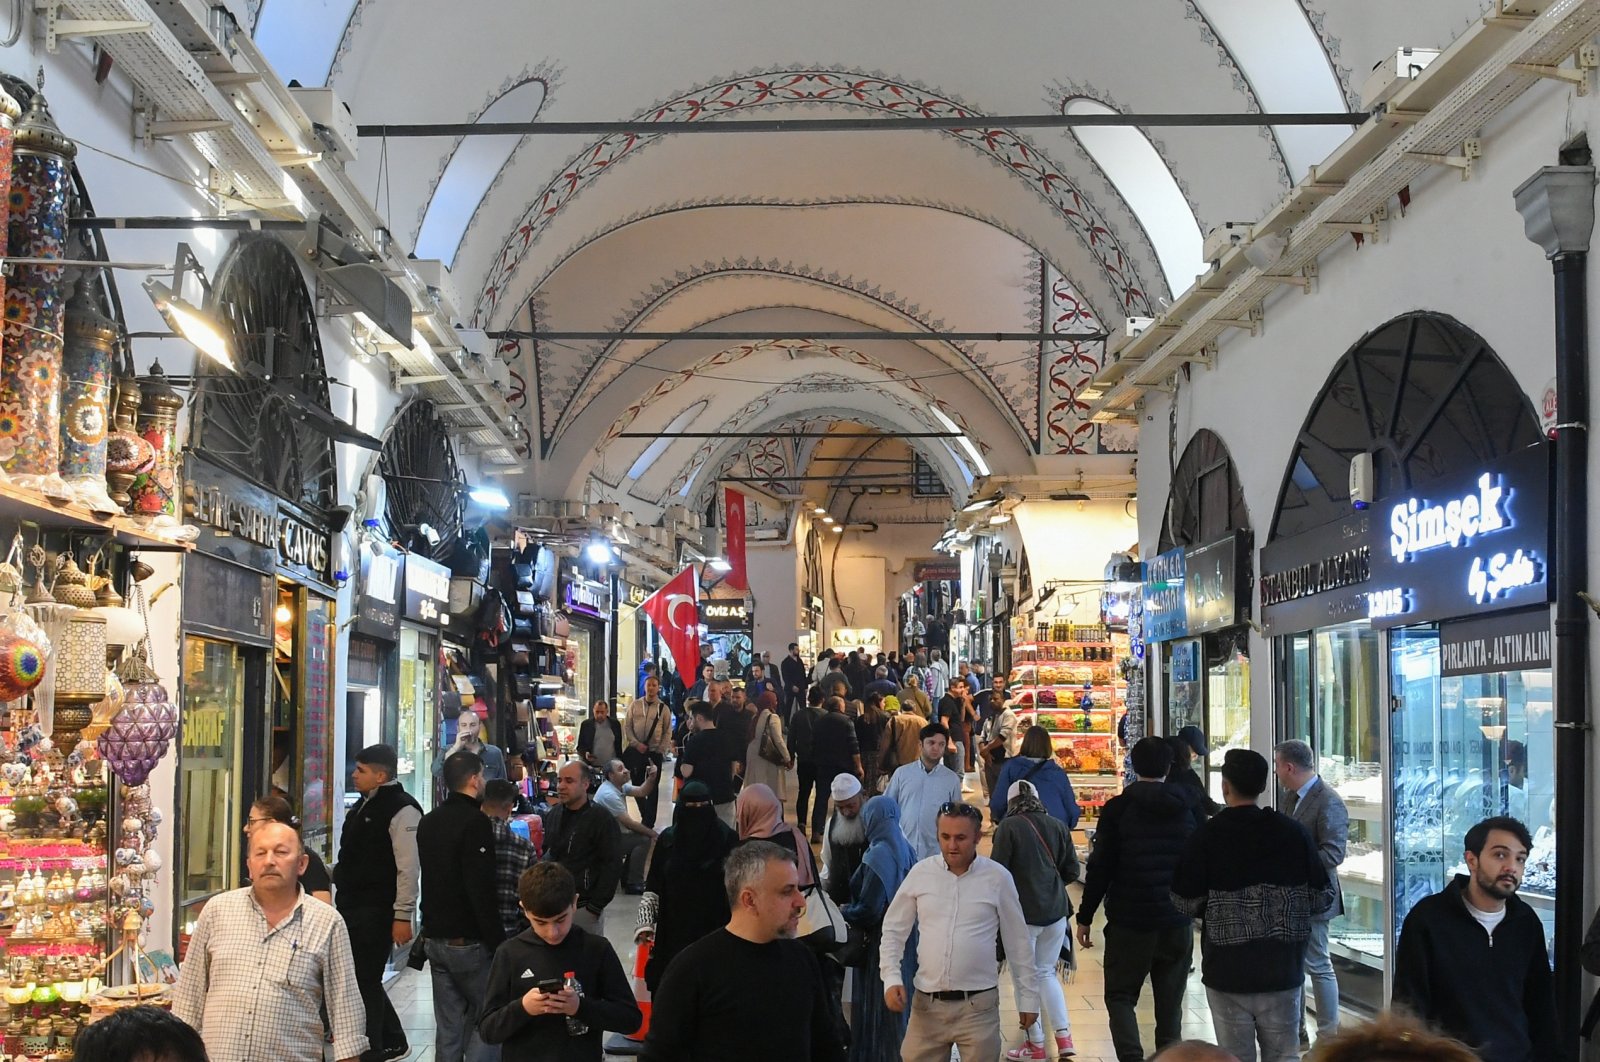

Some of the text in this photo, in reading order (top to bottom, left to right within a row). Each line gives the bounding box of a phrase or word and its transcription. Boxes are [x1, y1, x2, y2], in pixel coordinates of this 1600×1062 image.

[1390, 472, 1503, 563] Şimşek
[283, 517, 328, 581] ÇAVUŞ
[1442, 639, 1487, 670] PIRLANTA
[1493, 633, 1523, 665] ALTIN
[182, 710, 226, 747] SARRAF
